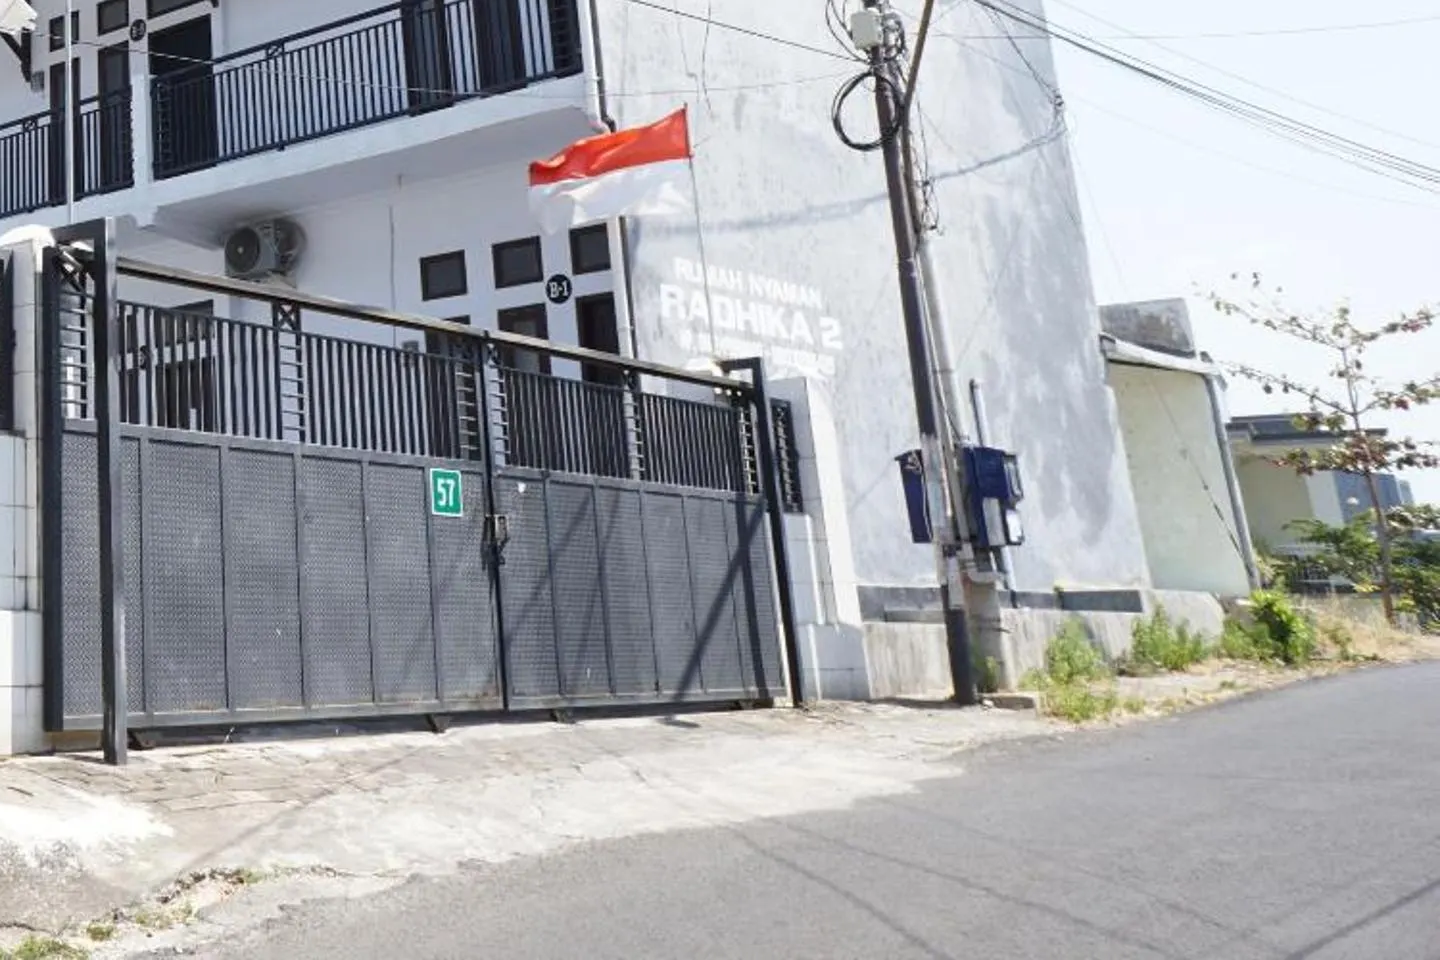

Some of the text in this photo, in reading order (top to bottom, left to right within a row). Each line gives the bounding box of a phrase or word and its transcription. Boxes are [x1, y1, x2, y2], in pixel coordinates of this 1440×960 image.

[549, 280, 569, 298] B-1
[660, 283, 844, 351] RADHIKA 2
[437, 477, 456, 507] 57
